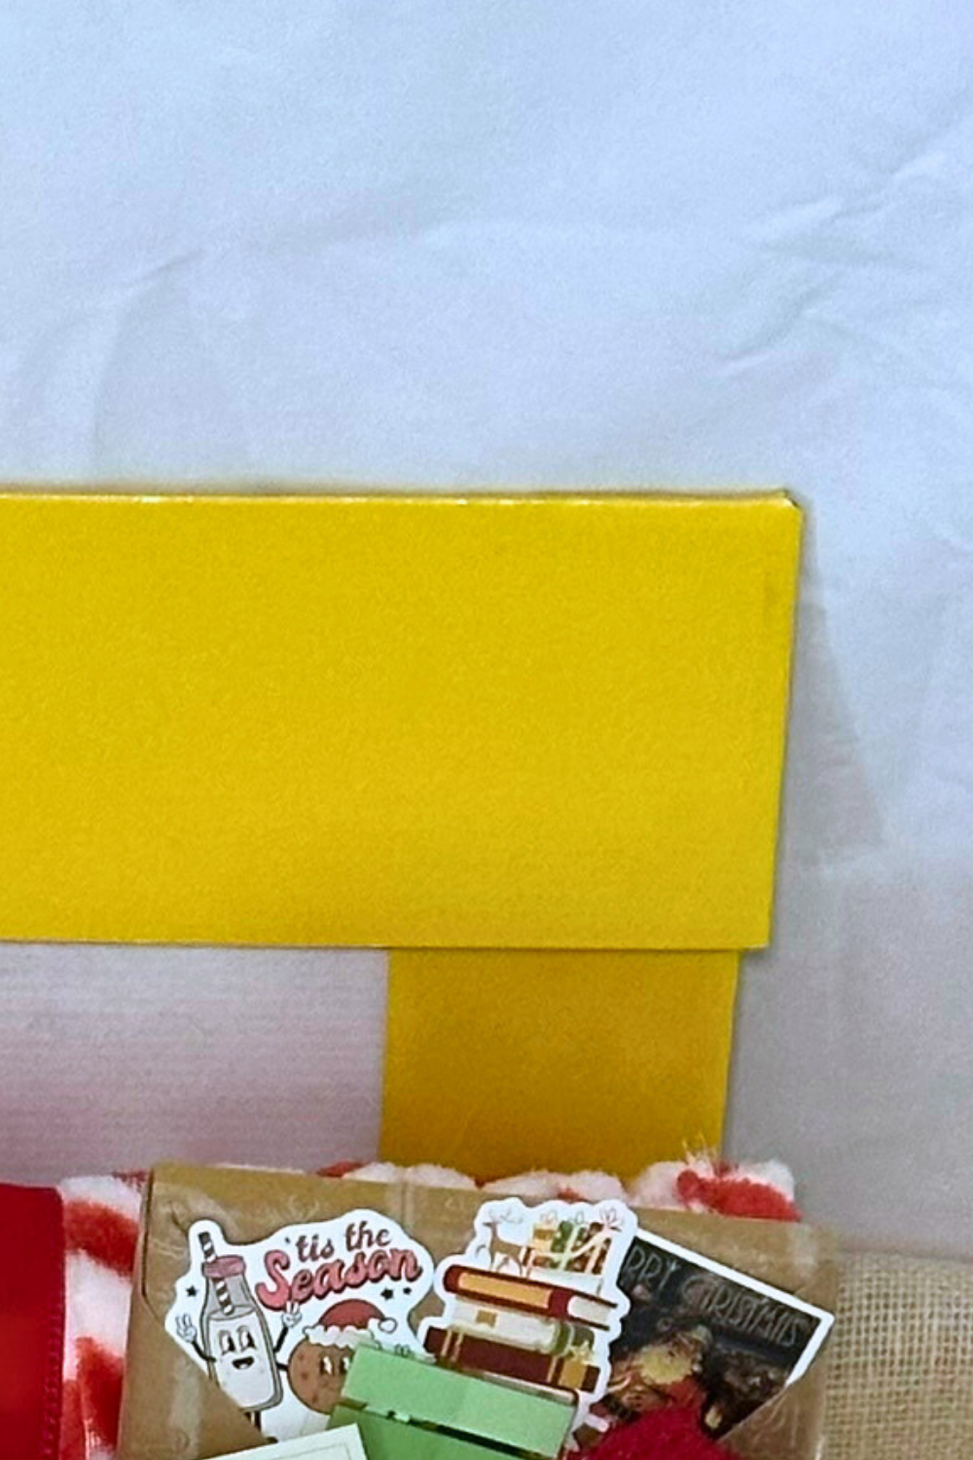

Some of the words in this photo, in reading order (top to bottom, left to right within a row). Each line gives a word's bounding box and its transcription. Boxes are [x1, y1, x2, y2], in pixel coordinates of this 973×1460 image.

[344, 1220, 392, 1251] the
[255, 1248, 423, 1311] Season
[621, 1243, 681, 1291] RRY
